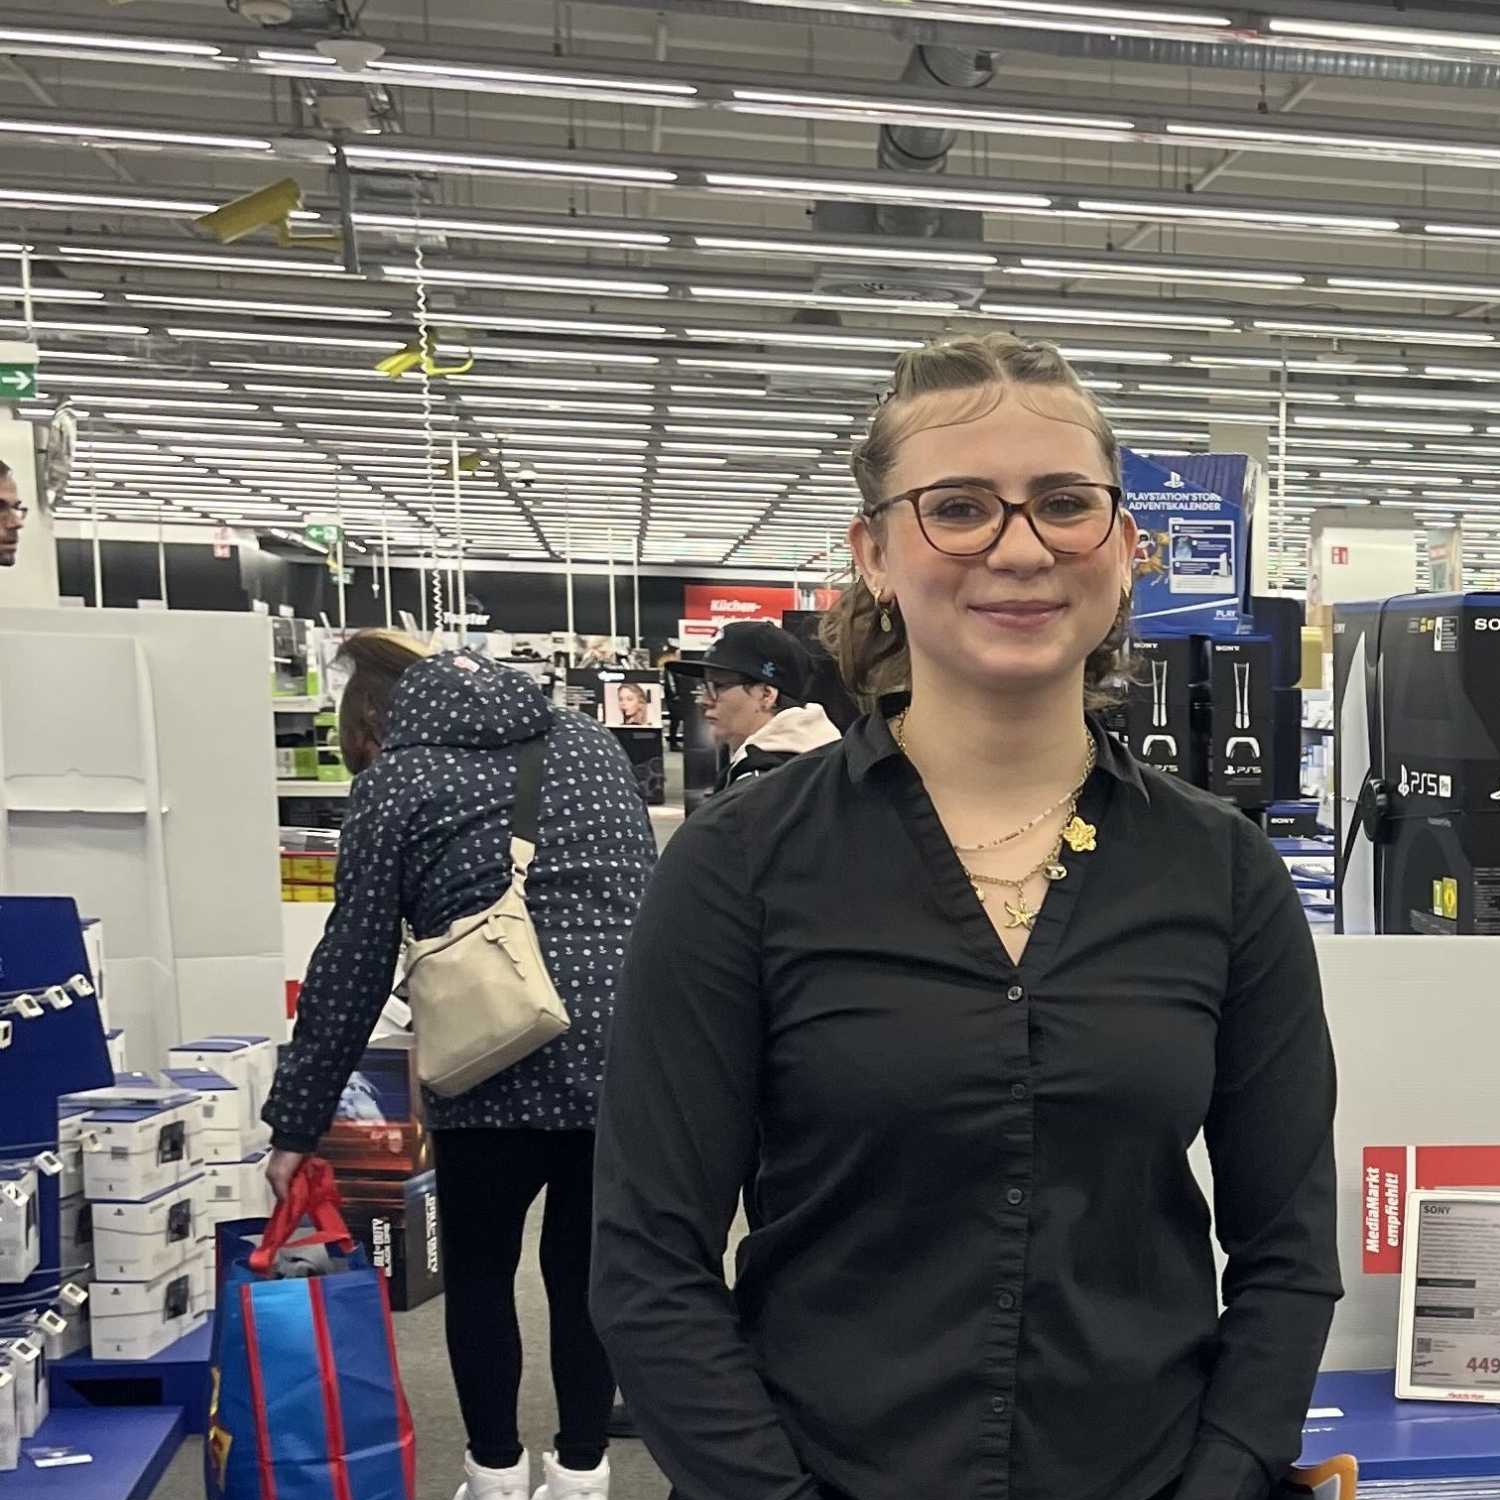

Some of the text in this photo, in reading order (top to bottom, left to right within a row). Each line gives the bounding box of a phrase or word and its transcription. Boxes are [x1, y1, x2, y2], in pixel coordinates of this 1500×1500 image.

[1128, 502, 1221, 511] ADVENTSKALENDER
[1215, 610, 1236, 618] PLAY
[1236, 766, 1262, 774] PS5
[1410, 771, 1438, 796] PS5
[1365, 1167, 1380, 1254] MediaMarkt
[1384, 1172, 1402, 1247] empfiehlt!
[1423, 1205, 1451, 1215] SONY
